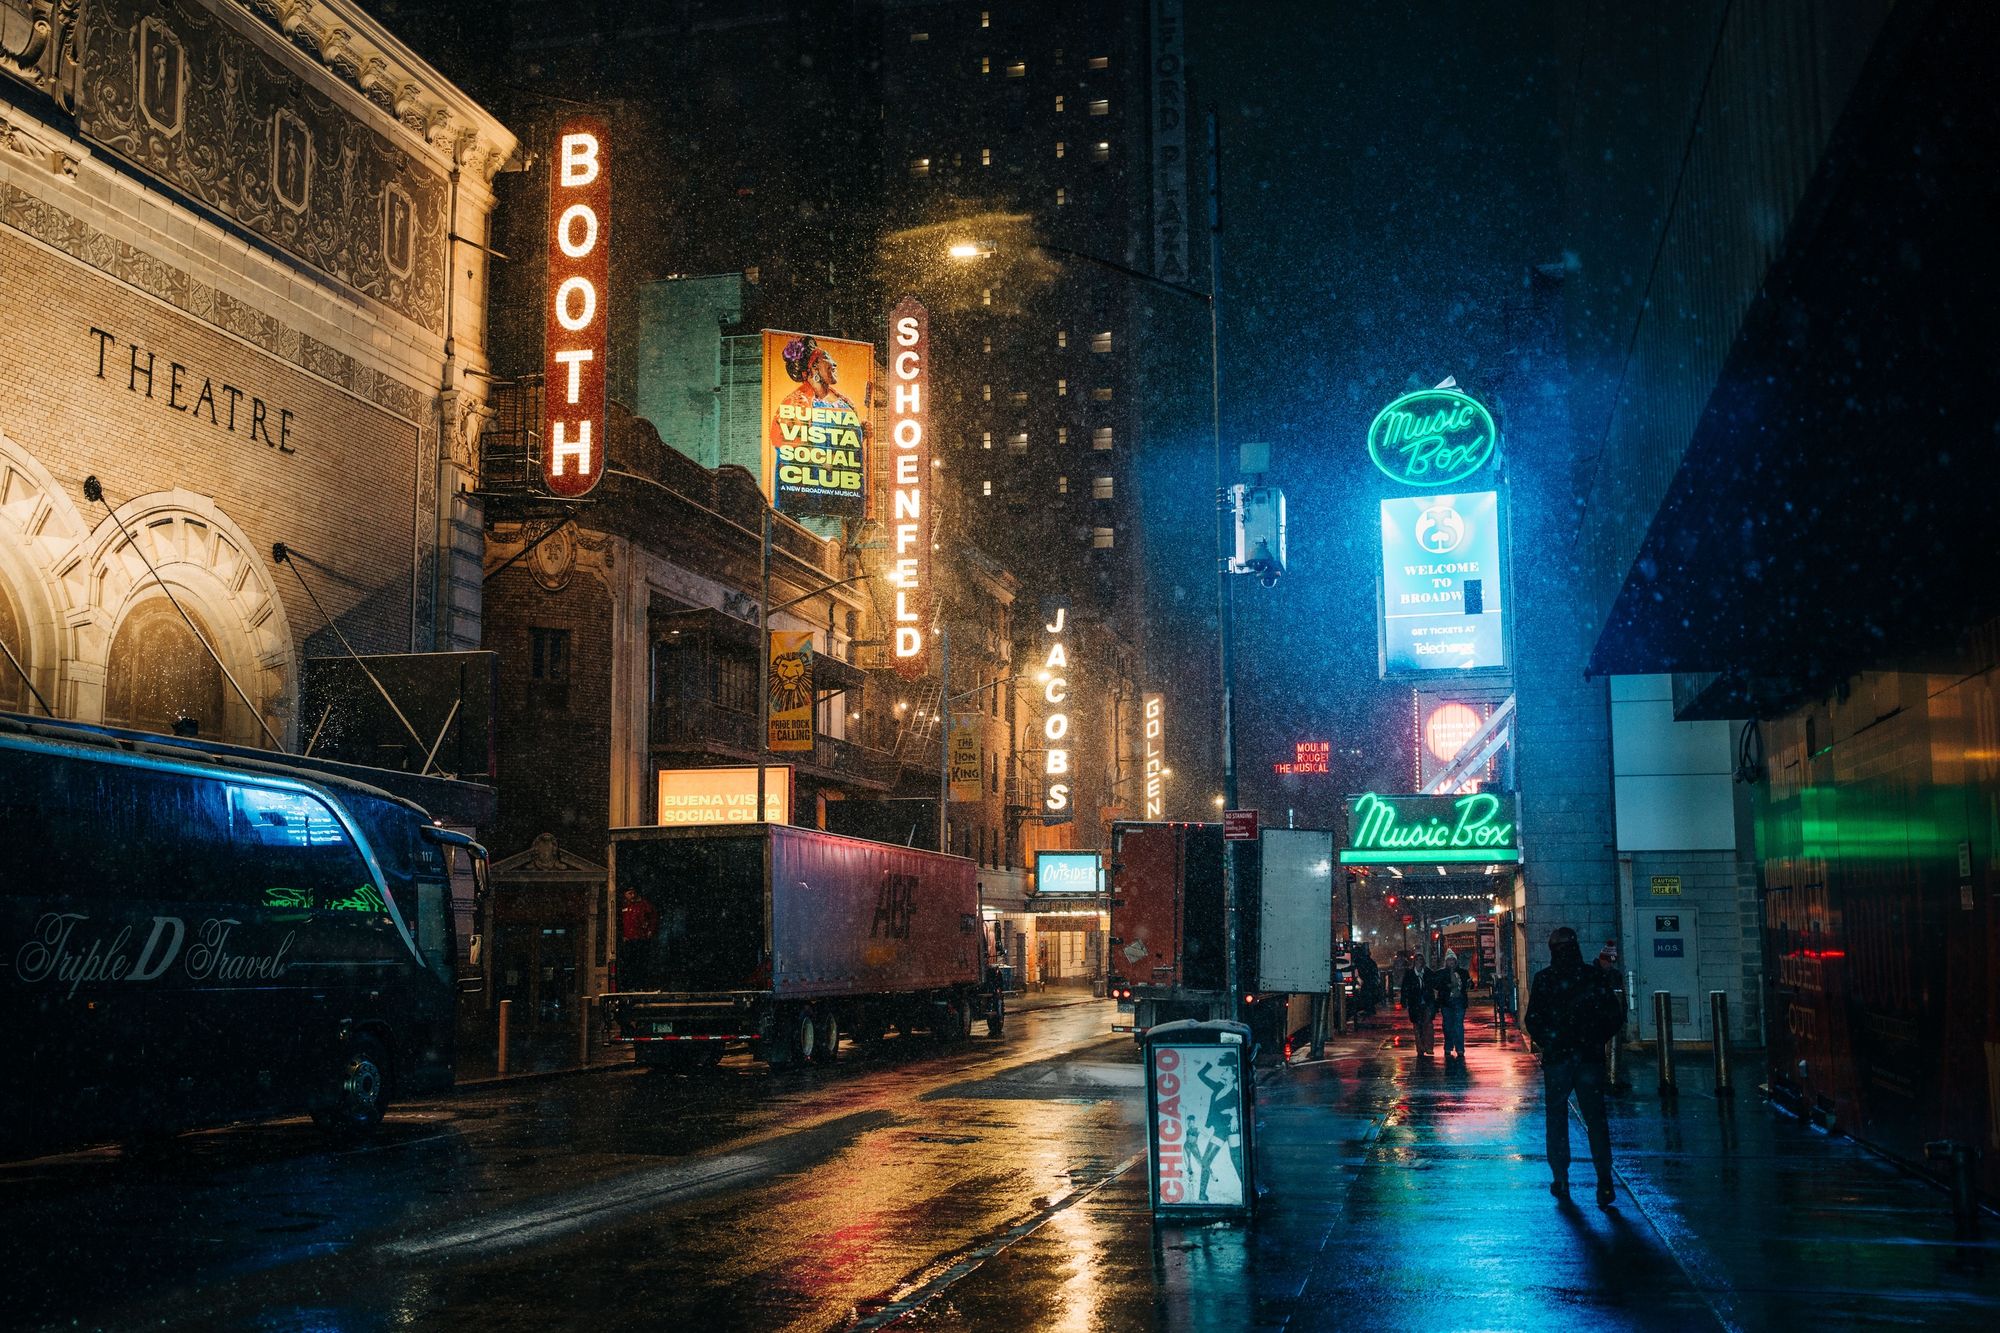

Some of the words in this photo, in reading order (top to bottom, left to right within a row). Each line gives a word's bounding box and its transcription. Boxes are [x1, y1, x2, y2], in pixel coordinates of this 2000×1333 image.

[552, 133, 601, 477] BOOTH
[89, 327, 296, 455] THEATRE
[779, 404, 860, 427] BUENA
[1383, 400, 1475, 448] Music
[779, 422, 860, 448] VISTA
[779, 444, 861, 468] SOCIAL
[1401, 433, 1486, 477] Box
[779, 465, 861, 490] CLUB
[801, 487, 835, 495] BROADWAY
[834, 490, 861, 498] MUSICAL
[895, 316, 922, 658] SCHOENFELD
[1403, 561, 1480, 576] WELCOME
[1431, 578, 1452, 589] TO
[1400, 590, 1486, 605] BROADW!
[1411, 627, 1429, 636] GET
[1429, 626, 1463, 635] TICKETS
[1464, 625, 1476, 633] AT
[1045, 607, 1069, 810] JACOBS
[770, 719, 791, 730] PRIDE
[792, 719, 810, 729] ROCK
[777, 729, 811, 741] CALLING
[957, 738, 974, 748] THE
[1297, 742, 1329, 753] MOULIN
[954, 750, 976, 765] LION
[1146, 698, 1161, 819] GOLDEN
[1297, 753, 1329, 763] ROUGE!
[951, 767, 979, 783] KING
[1274, 764, 1292, 774] THE
[1293, 763, 1329, 773] MUSICAL
[665, 794, 723, 806] BUENA
[664, 808, 725, 822] SOCIAL
[1354, 791, 1449, 849] Music
[1450, 792, 1512, 849] Box
[421, 850, 433, 863] 117
[16, 912, 131, 1000] Triple
[125, 916, 185, 981] D
[184, 917, 297, 981] Travel
[1155, 1048, 1185, 1204] CHICAGO
